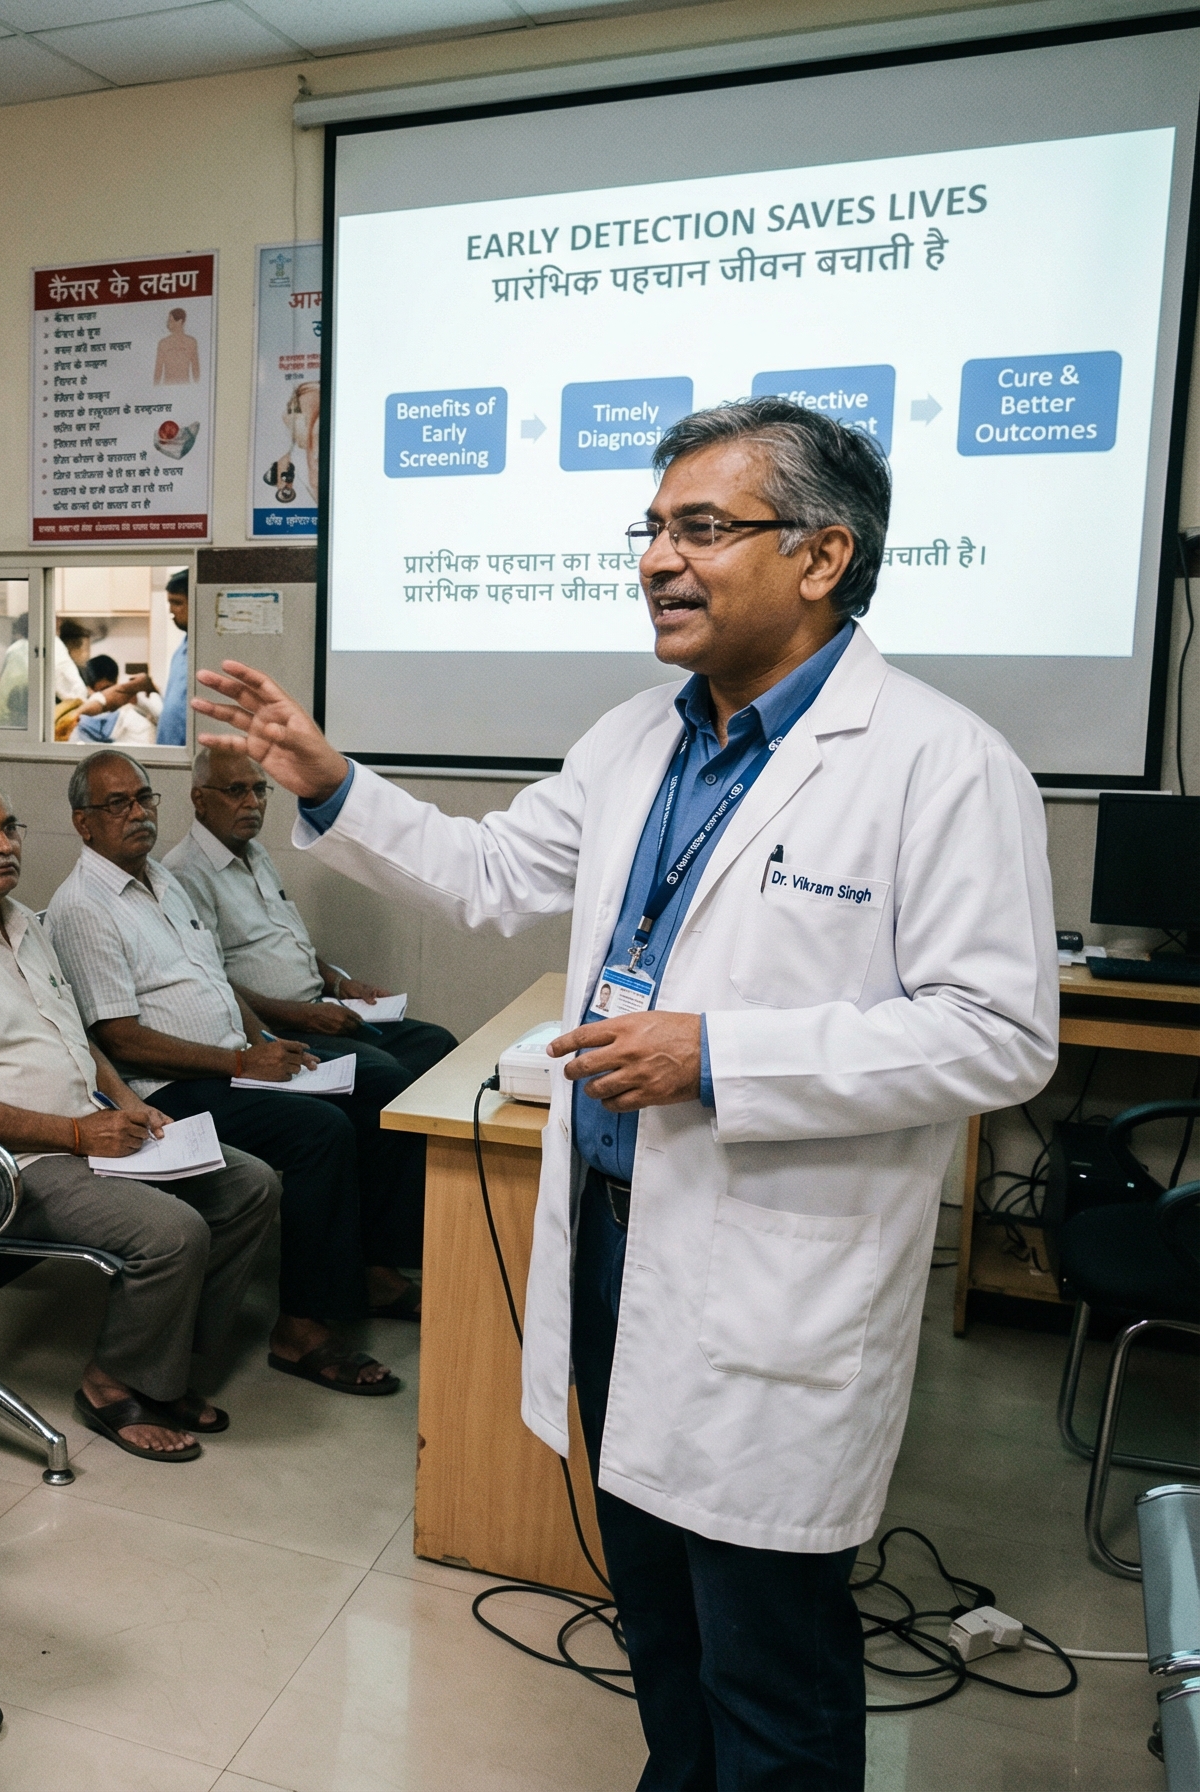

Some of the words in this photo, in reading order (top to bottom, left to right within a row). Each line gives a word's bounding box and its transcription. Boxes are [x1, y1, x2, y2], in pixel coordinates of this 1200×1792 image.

[466, 226, 560, 261] EARLY
[570, 207, 755, 251] DETECTION
[767, 195, 876, 233] SAVES
[888, 183, 988, 222] LIVES
[491, 264, 602, 303] प्रारंभिक
[610, 260, 711, 295] पहचान
[719, 246, 806, 283] जीवन
[814, 232, 914, 275] बचाती
[923, 227, 950, 271] है
[47, 273, 101, 303] कैंसर
[107, 269, 131, 299] के
[137, 270, 200, 296] लक्षण
[998, 368, 1053, 389] Cure
[1059, 364, 1080, 386] &
[396, 399, 470, 420] Benefits
[475, 396, 497, 417] of
[593, 401, 660, 424] Timely
[1000, 395, 1076, 416] Better
[422, 423, 467, 445] Early
[578, 426, 665, 451] Diagnosi
[975, 420, 1098, 443] Outcomes
[399, 448, 489, 469] Screening
[403, 549, 481, 574] प्रारंभिक
[486, 553, 555, 575] पहचान
[561, 553, 591, 572] का
[403, 577, 480, 603] प्रारंभिक
[485, 583, 554, 604] पहचान
[561, 576, 619, 601] जीवन
[625, 583, 640, 601] ब
[771, 870, 787, 886] Dr.
[792, 874, 834, 897] Vikram
[837, 884, 872, 904] Singh
